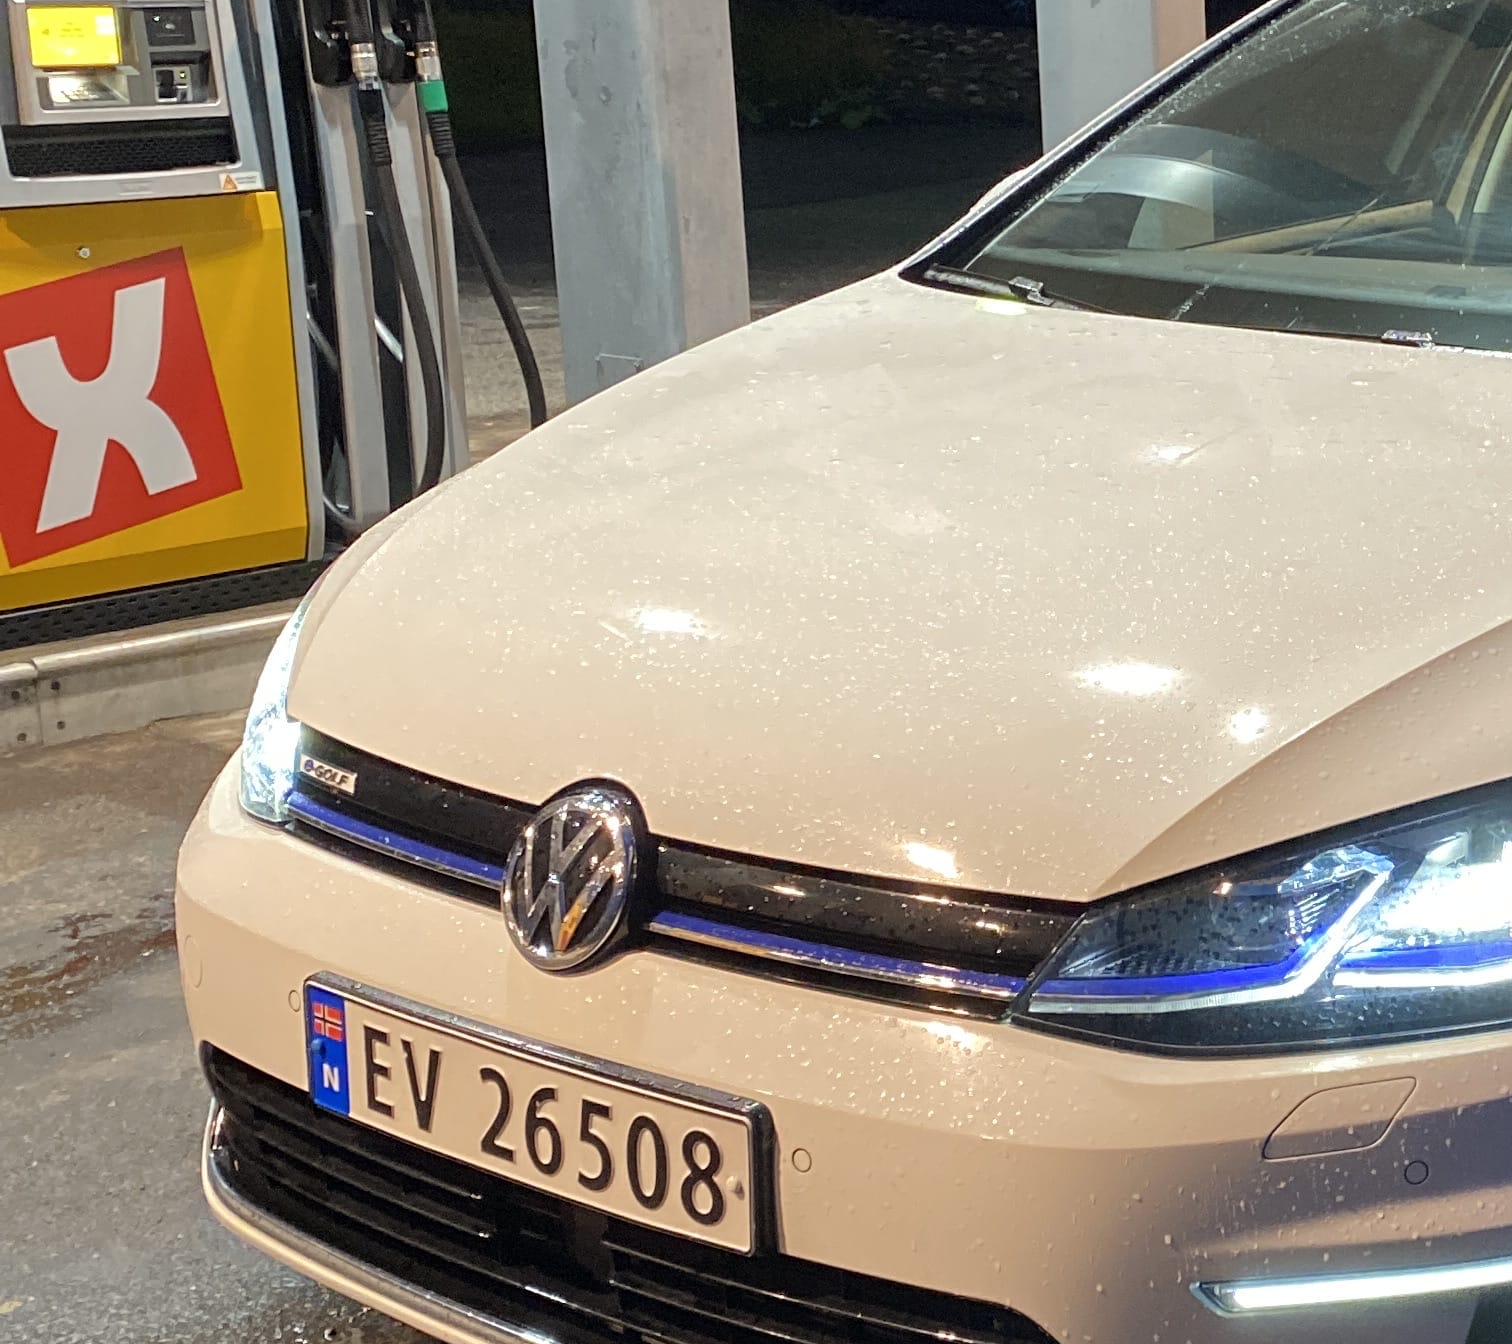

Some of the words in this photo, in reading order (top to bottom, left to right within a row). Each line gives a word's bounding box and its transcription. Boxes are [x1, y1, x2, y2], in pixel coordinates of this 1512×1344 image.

[3, 277, 198, 535] X
[322, 1062, 340, 1093] N
[363, 1024, 441, 1133] EV
[479, 1066, 727, 1227] 26508
